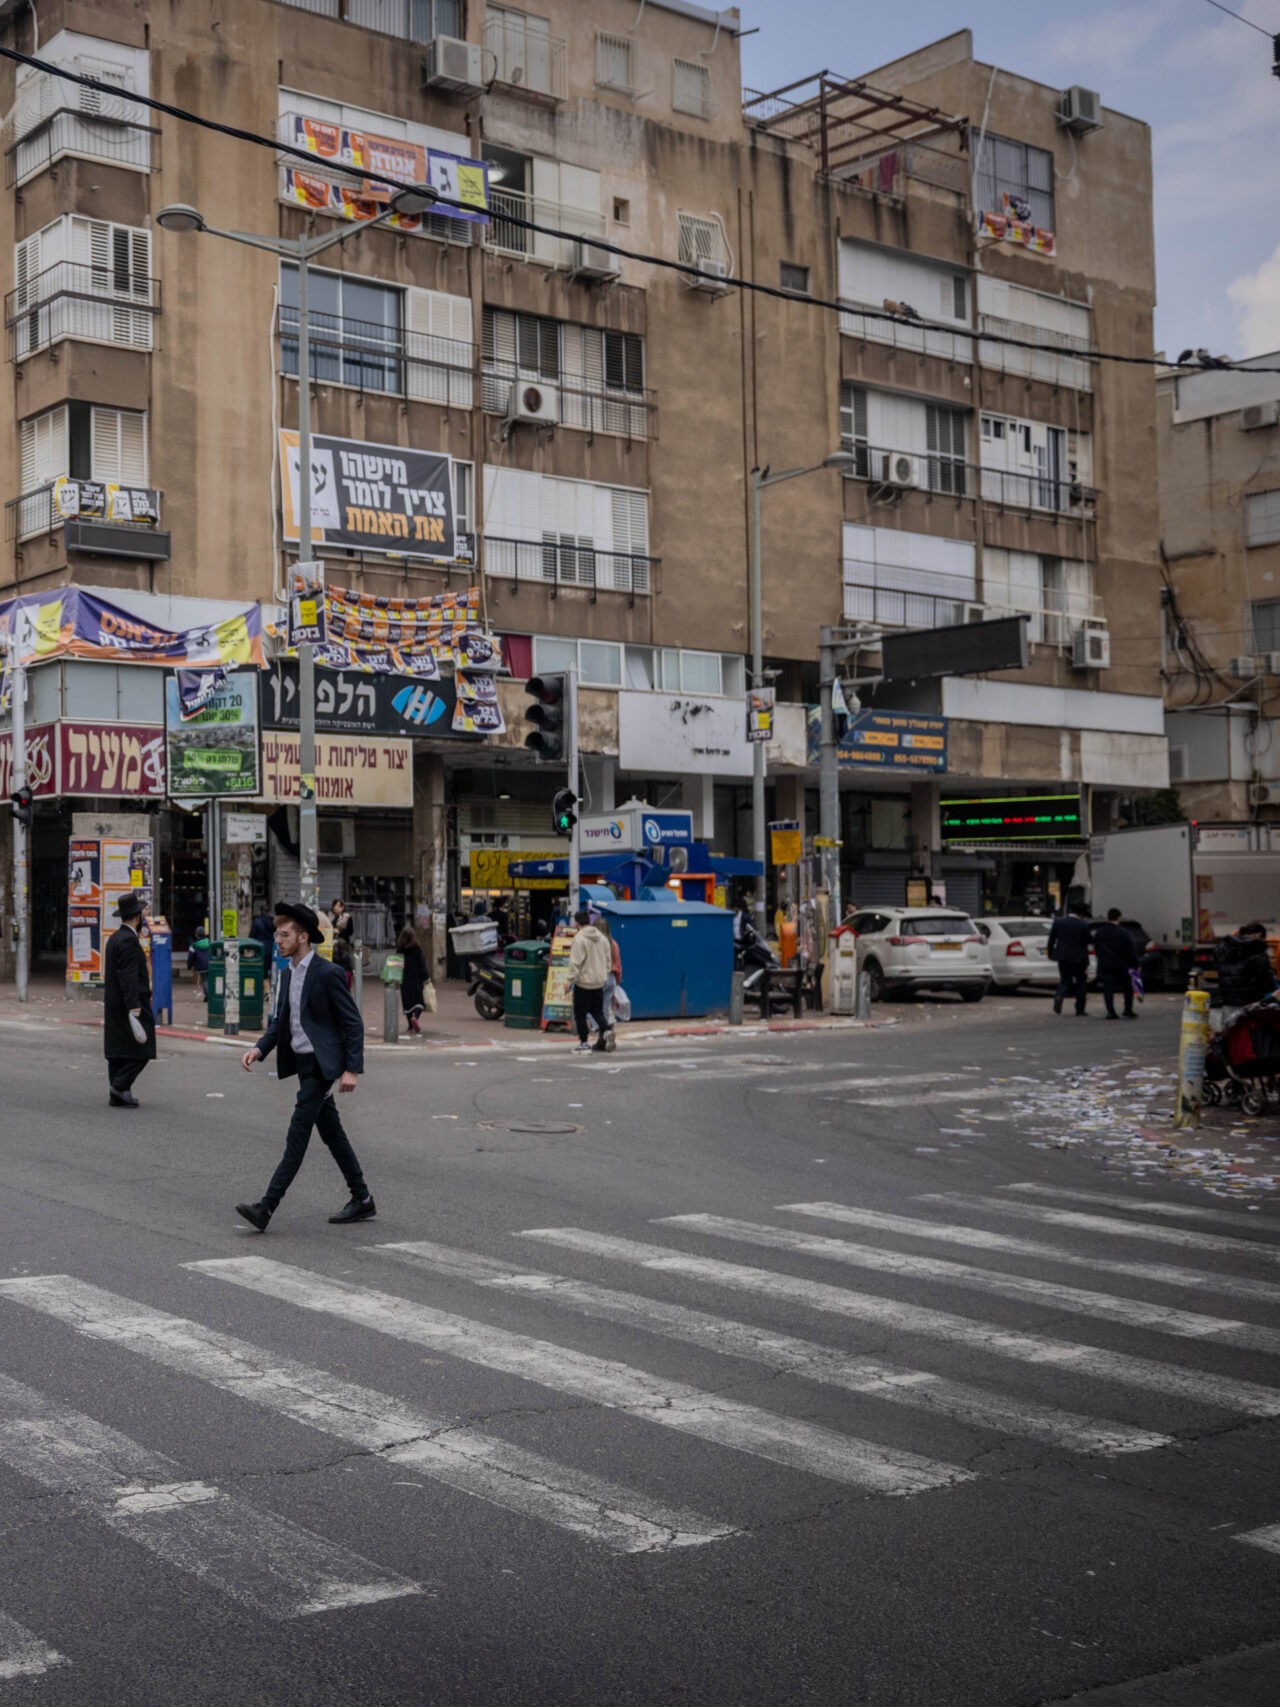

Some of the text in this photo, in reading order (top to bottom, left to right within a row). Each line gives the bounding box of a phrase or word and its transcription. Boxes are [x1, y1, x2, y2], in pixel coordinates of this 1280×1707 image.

[339, 451, 408, 485] מישהו
[342, 478, 446, 516] צריך לומר
[345, 506, 446, 542] את האמת
[230, 694, 243, 706] 20
[270, 672, 376, 723] הלפין
[328, 744, 377, 768] טליתות
[383, 748, 408, 770] יצור
[268, 775, 301, 796] בעור
